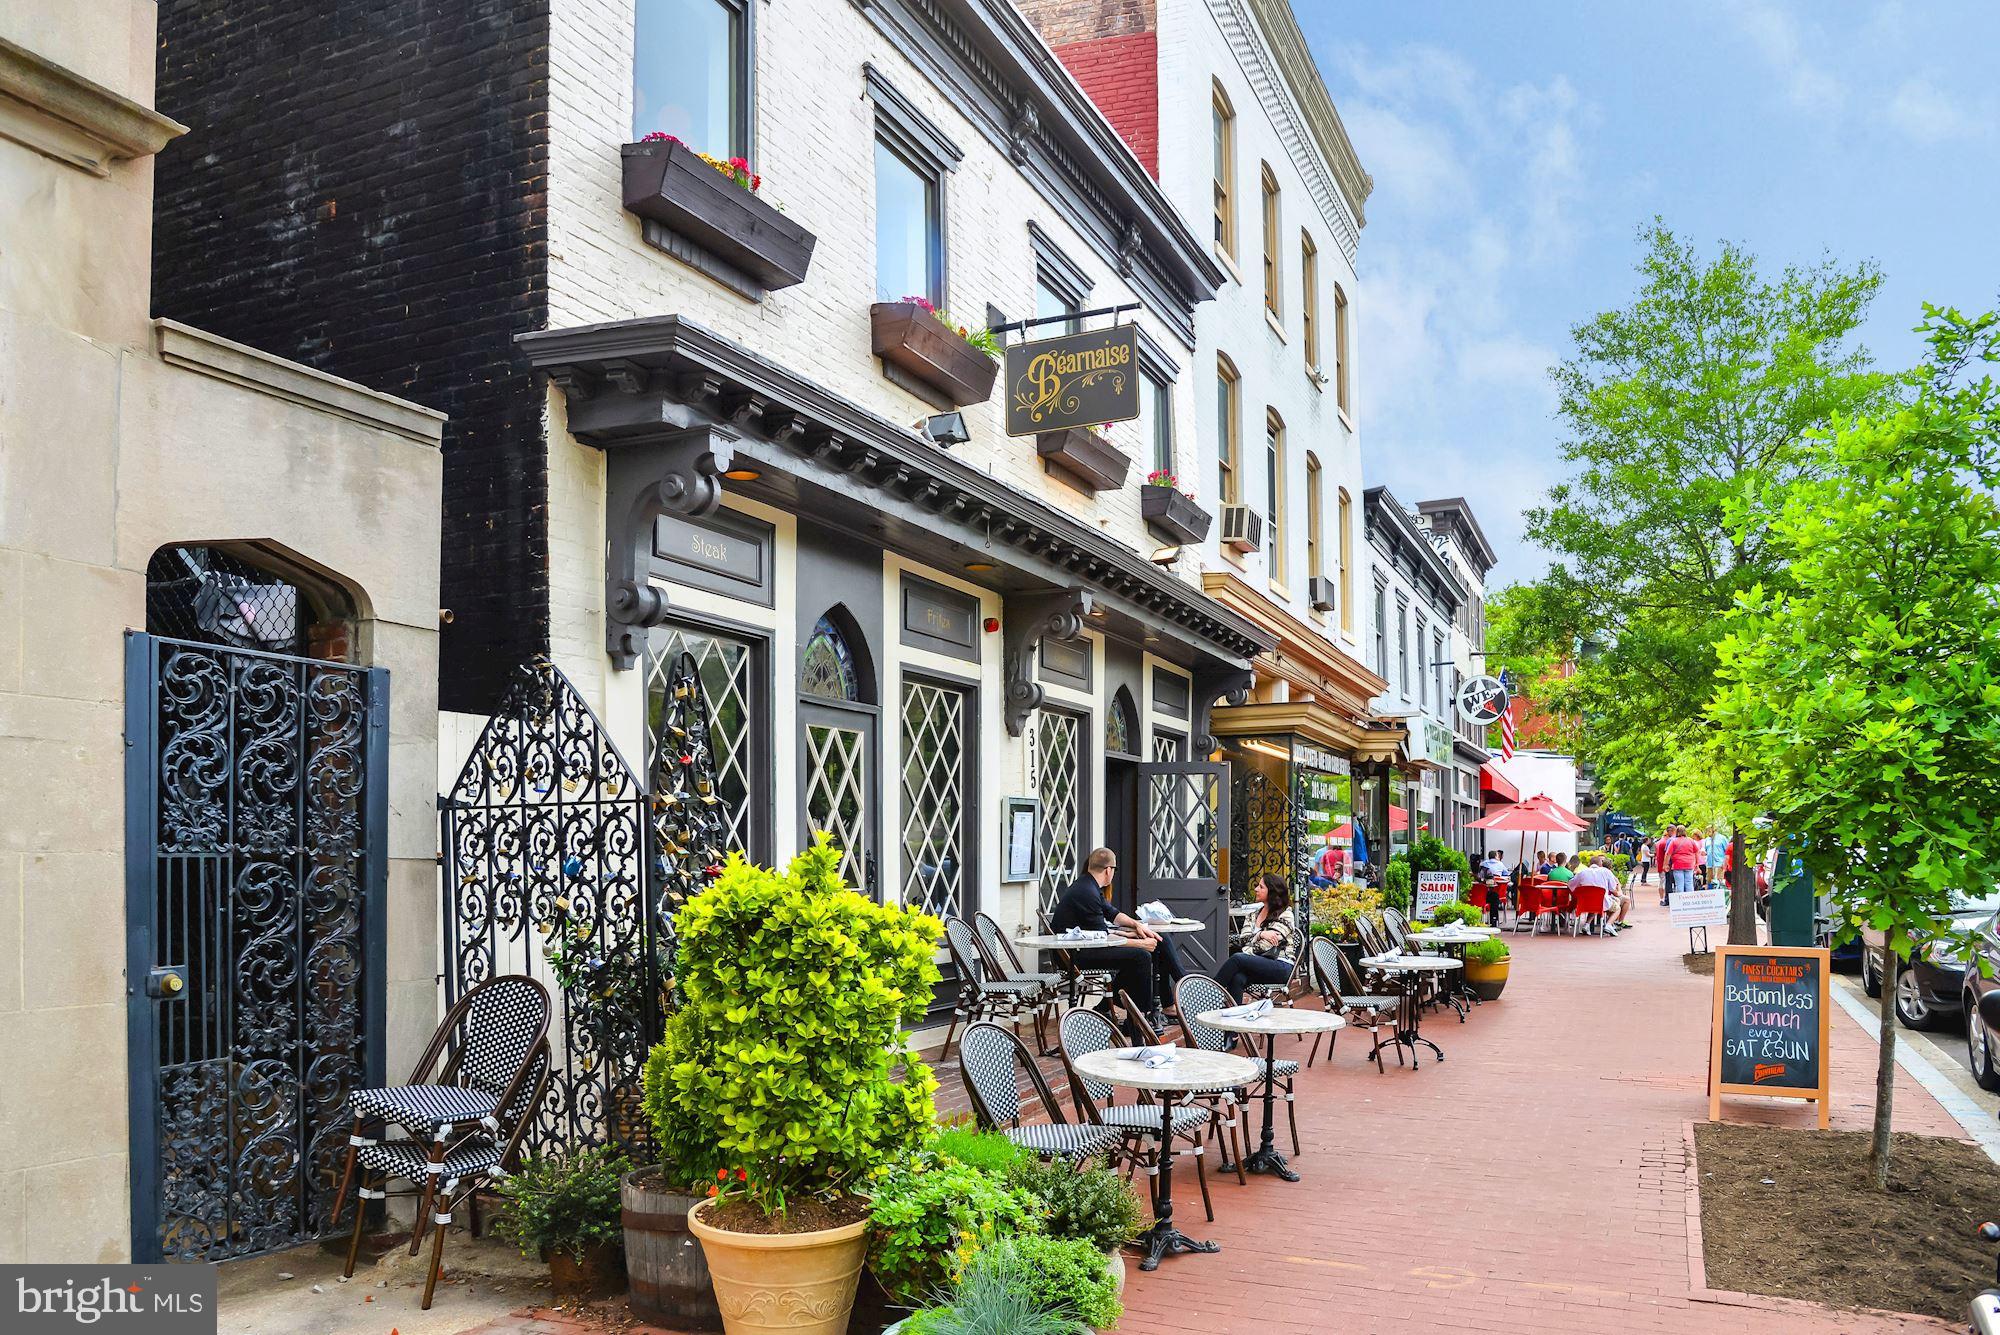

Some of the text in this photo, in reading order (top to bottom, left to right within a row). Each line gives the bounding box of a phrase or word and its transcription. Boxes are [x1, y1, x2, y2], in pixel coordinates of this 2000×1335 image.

[692, 534, 728, 562] Steak
[1029, 728, 1037, 789] 315
[1420, 873, 1456, 882] FULL SERVICE
[1420, 883, 1454, 892] SALON
[1741, 964, 1804, 978] FINEST COCKTAILS
[1725, 984, 1813, 1009] Bottomless
[1740, 1004, 1800, 1030] Brunch
[1748, 1028, 1783, 1043] every
[1726, 1039, 1758, 1058] SAT
